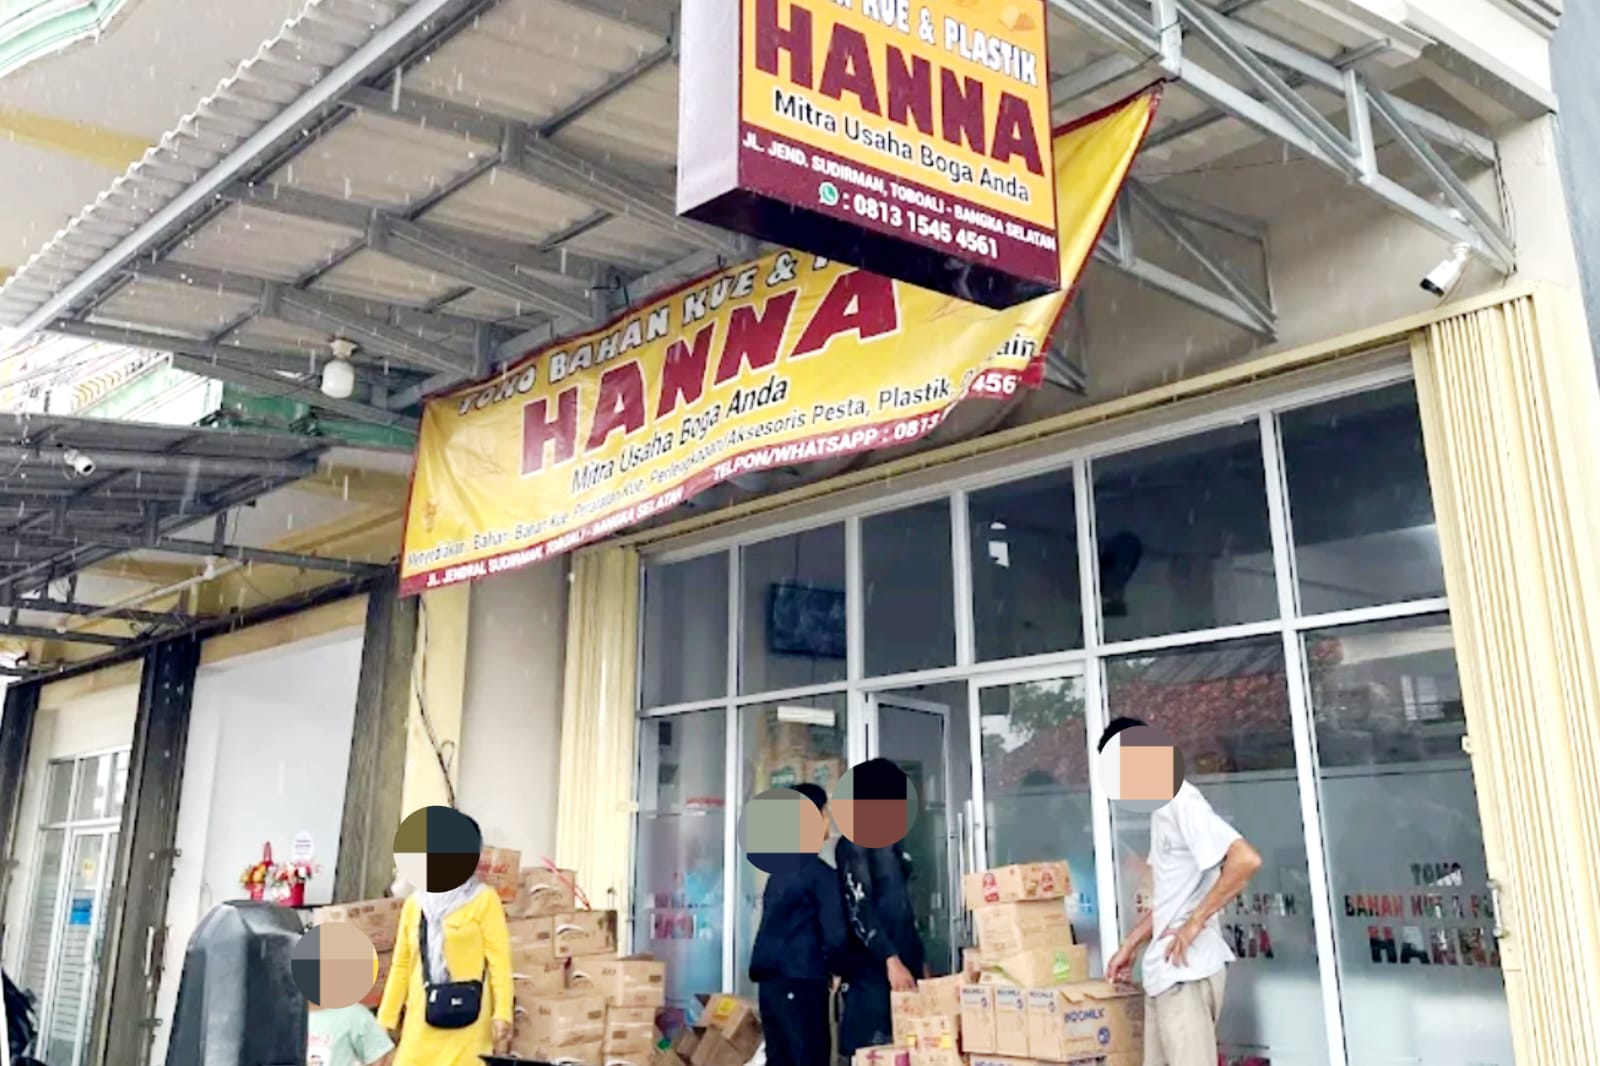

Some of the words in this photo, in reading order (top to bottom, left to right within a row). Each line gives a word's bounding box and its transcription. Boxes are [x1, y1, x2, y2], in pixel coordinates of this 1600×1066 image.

[755, 0, 1044, 176] HANNA
[918, 7, 935, 45] &
[944, 17, 1037, 86] PLASTIK
[742, 132, 764, 152] JL.
[768, 141, 808, 168] JEND.
[811, 155, 888, 197] SUDIRMAN,
[889, 184, 945, 213] TOBOALI
[954, 204, 1003, 234] BANGKA
[1005, 220, 1057, 252] SELATAN
[775, 89, 836, 133] Mitra
[845, 116, 913, 160] Usaha
[920, 144, 974, 185] Boga
[980, 168, 1030, 203] Anda
[853, 194, 903, 228] 0813
[906, 210, 951, 243] 1545
[955, 228, 998, 259] 4561
[458, 367, 536, 416] TOKO
[550, 304, 670, 384] BAHAN
[681, 264, 761, 327] KUE
[766, 250, 798, 288] &
[521, 264, 897, 476] HANNA
[572, 459, 615, 493] Mitra
[620, 430, 673, 472] Usaha
[679, 404, 721, 445] Boga
[727, 375, 788, 418] Anda
[713, 429, 879, 480] TELPON/WHATSAPP
[812, 400, 870, 424] Pesta,
[879, 378, 951, 411] Plastik
